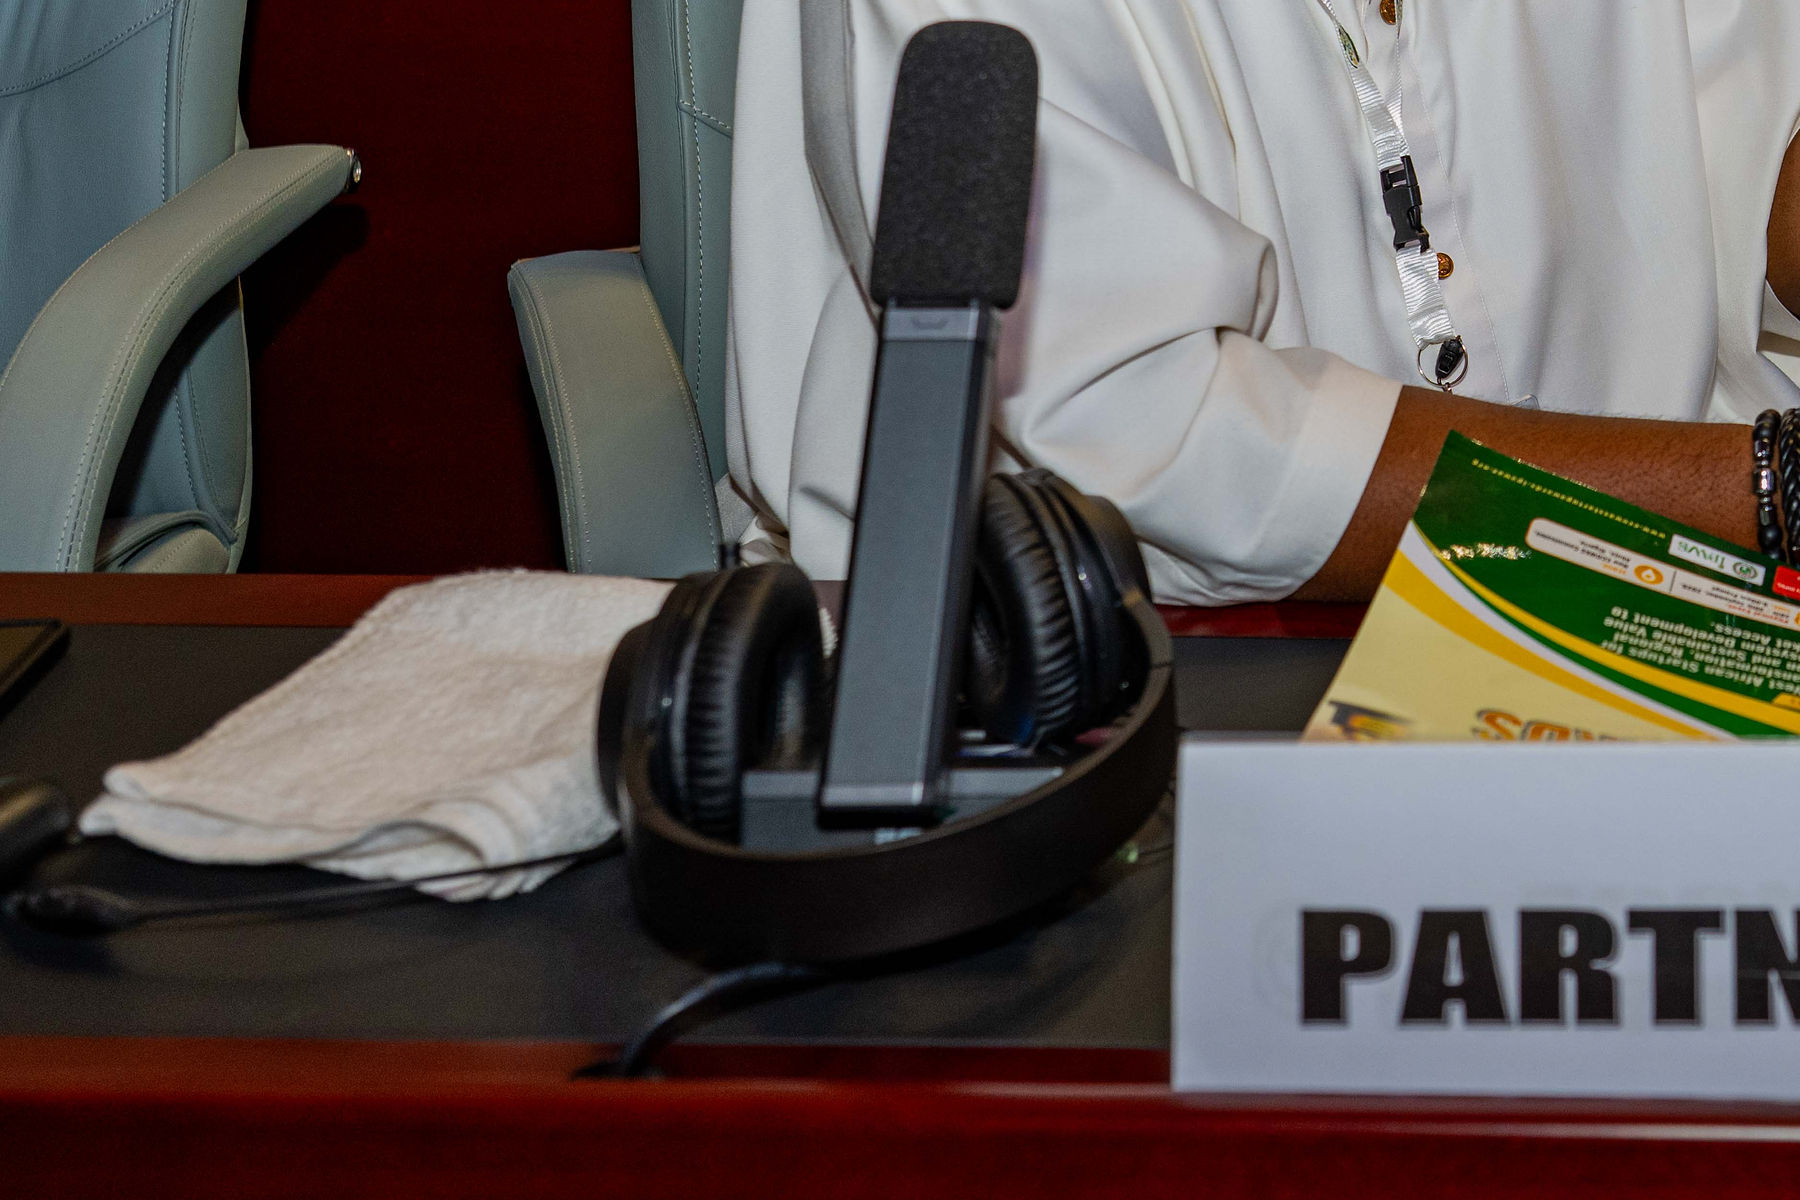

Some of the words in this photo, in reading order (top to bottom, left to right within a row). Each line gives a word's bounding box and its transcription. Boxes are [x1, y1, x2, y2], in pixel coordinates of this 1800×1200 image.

[1611, 606, 1628, 620] to
[1603, 616, 1647, 637] Value
[1634, 613, 1736, 648] Development
[1710, 622, 1771, 646] Access.
[1600, 640, 1623, 655] for
[1613, 631, 1683, 658] Regional
[1651, 630, 1747, 661] Sustainable
[1628, 647, 1699, 673] Startups
[1751, 655, 1782, 668] and
[1704, 665, 1763, 688] African
